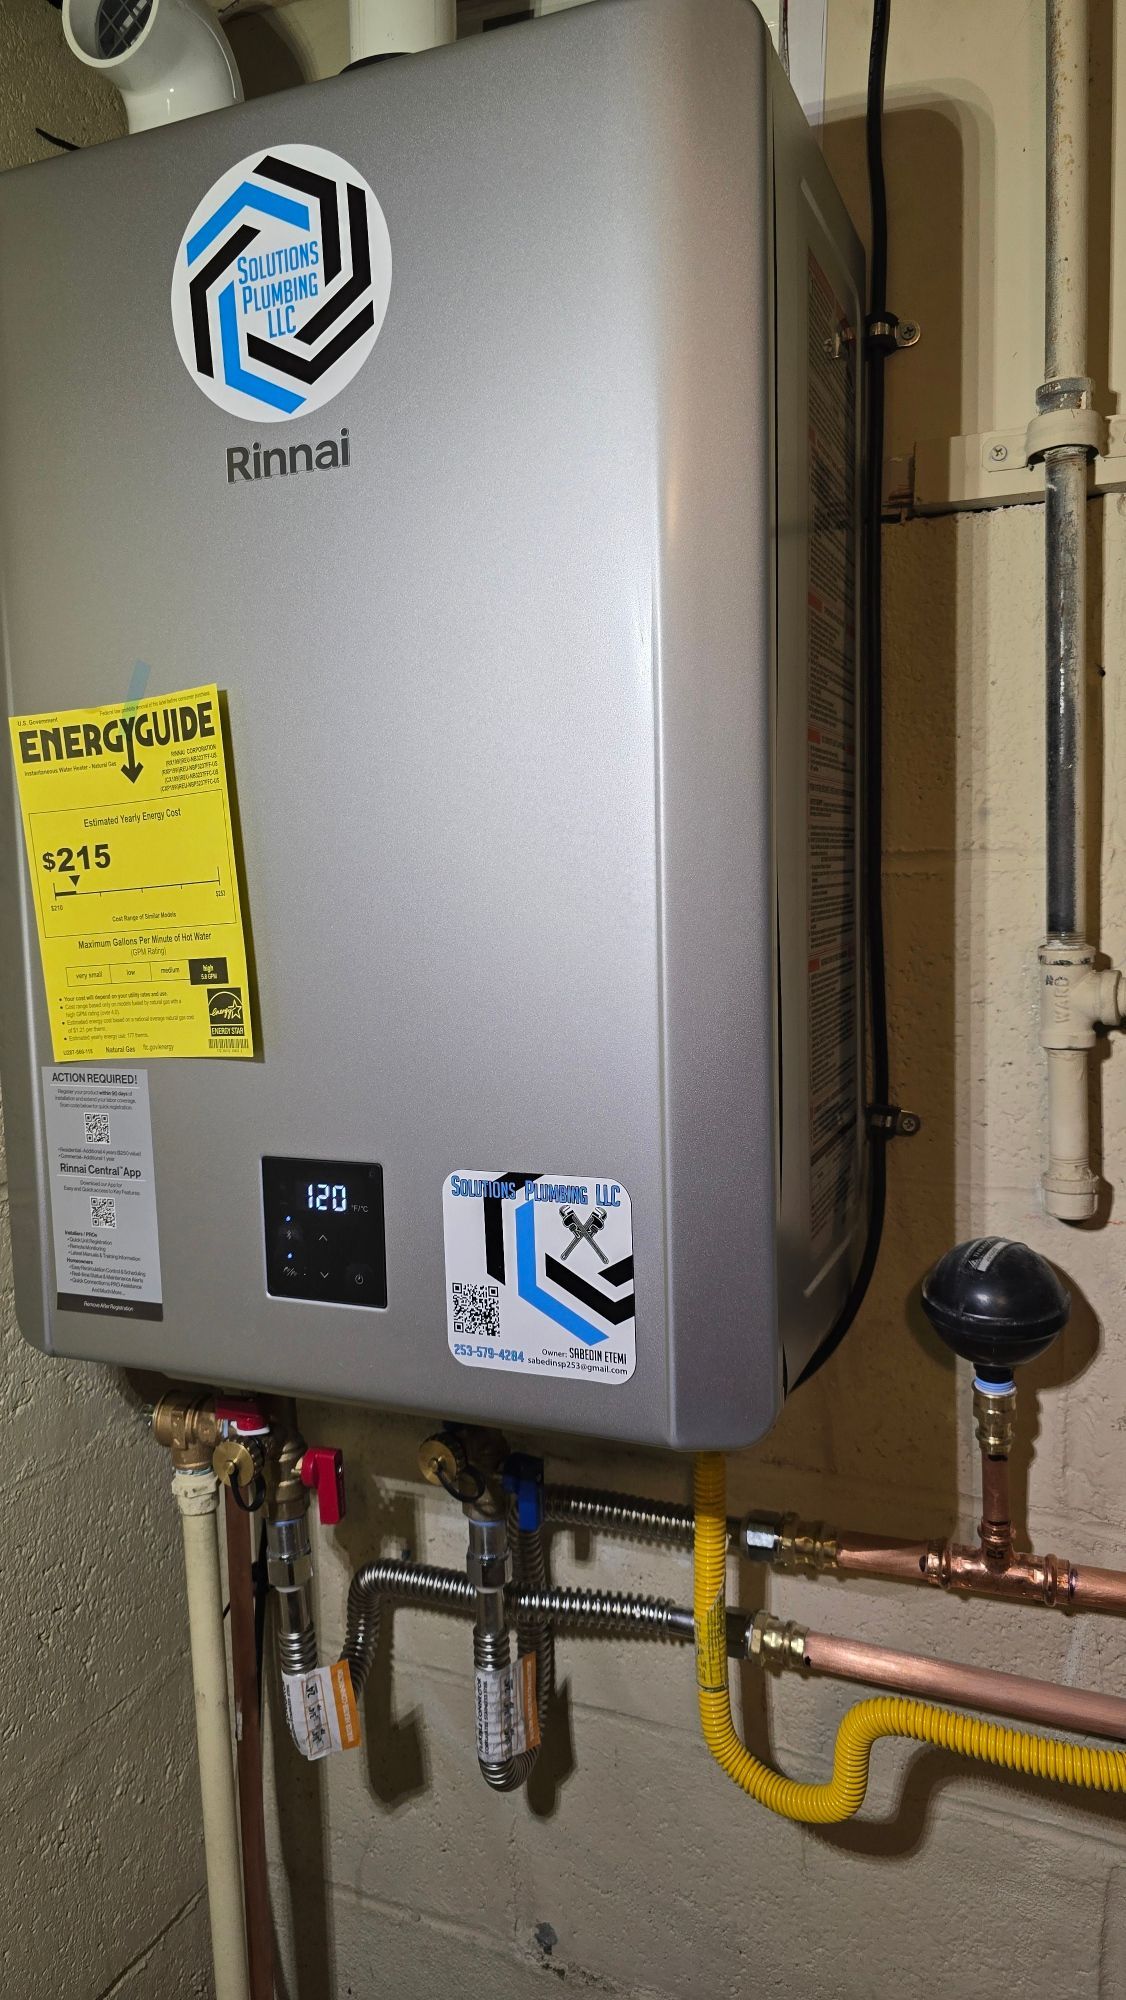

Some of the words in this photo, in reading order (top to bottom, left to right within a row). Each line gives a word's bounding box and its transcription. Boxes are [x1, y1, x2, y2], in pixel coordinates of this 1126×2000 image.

[237, 240, 319, 284] SOLUTIONS
[242, 272, 318, 314] PLUMBING
[268, 305, 296, 339] LLC
[226, 428, 350, 483] Rinnai
[29, 717, 58, 725] Government
[84, 816, 118, 827] Estimated
[120, 813, 140, 823] Yearly
[142, 810, 164, 821] Energy
[166, 808, 181, 818] Cost
[42, 844, 111, 872] $215
[79, 940, 111, 949] Maximum
[113, 938, 137, 946] Gallons
[152, 935, 172, 943] Minute
[131, 948, 146, 957] (GPM
[148, 947, 167, 956] Rating)
[52, 1072, 85, 1082] ACTION
[87, 1074, 137, 1084] REQUIRED!
[60, 1163, 86, 1173] Rinnai
[123, 1167, 141, 1178] App
[307, 1183, 347, 1212] 120
[450, 1175, 516, 1200] SOLUTIONS
[524, 1180, 588, 1205] PLUMBING
[595, 1183, 621, 1207] LLC
[528, 1356, 628, 1376] sabedinsp253@gmail.com
[542, 1348, 567, 1358] Owner:
[569, 1348, 602, 1363] SABEDIN
[604, 1351, 627, 1365] ETEMI
